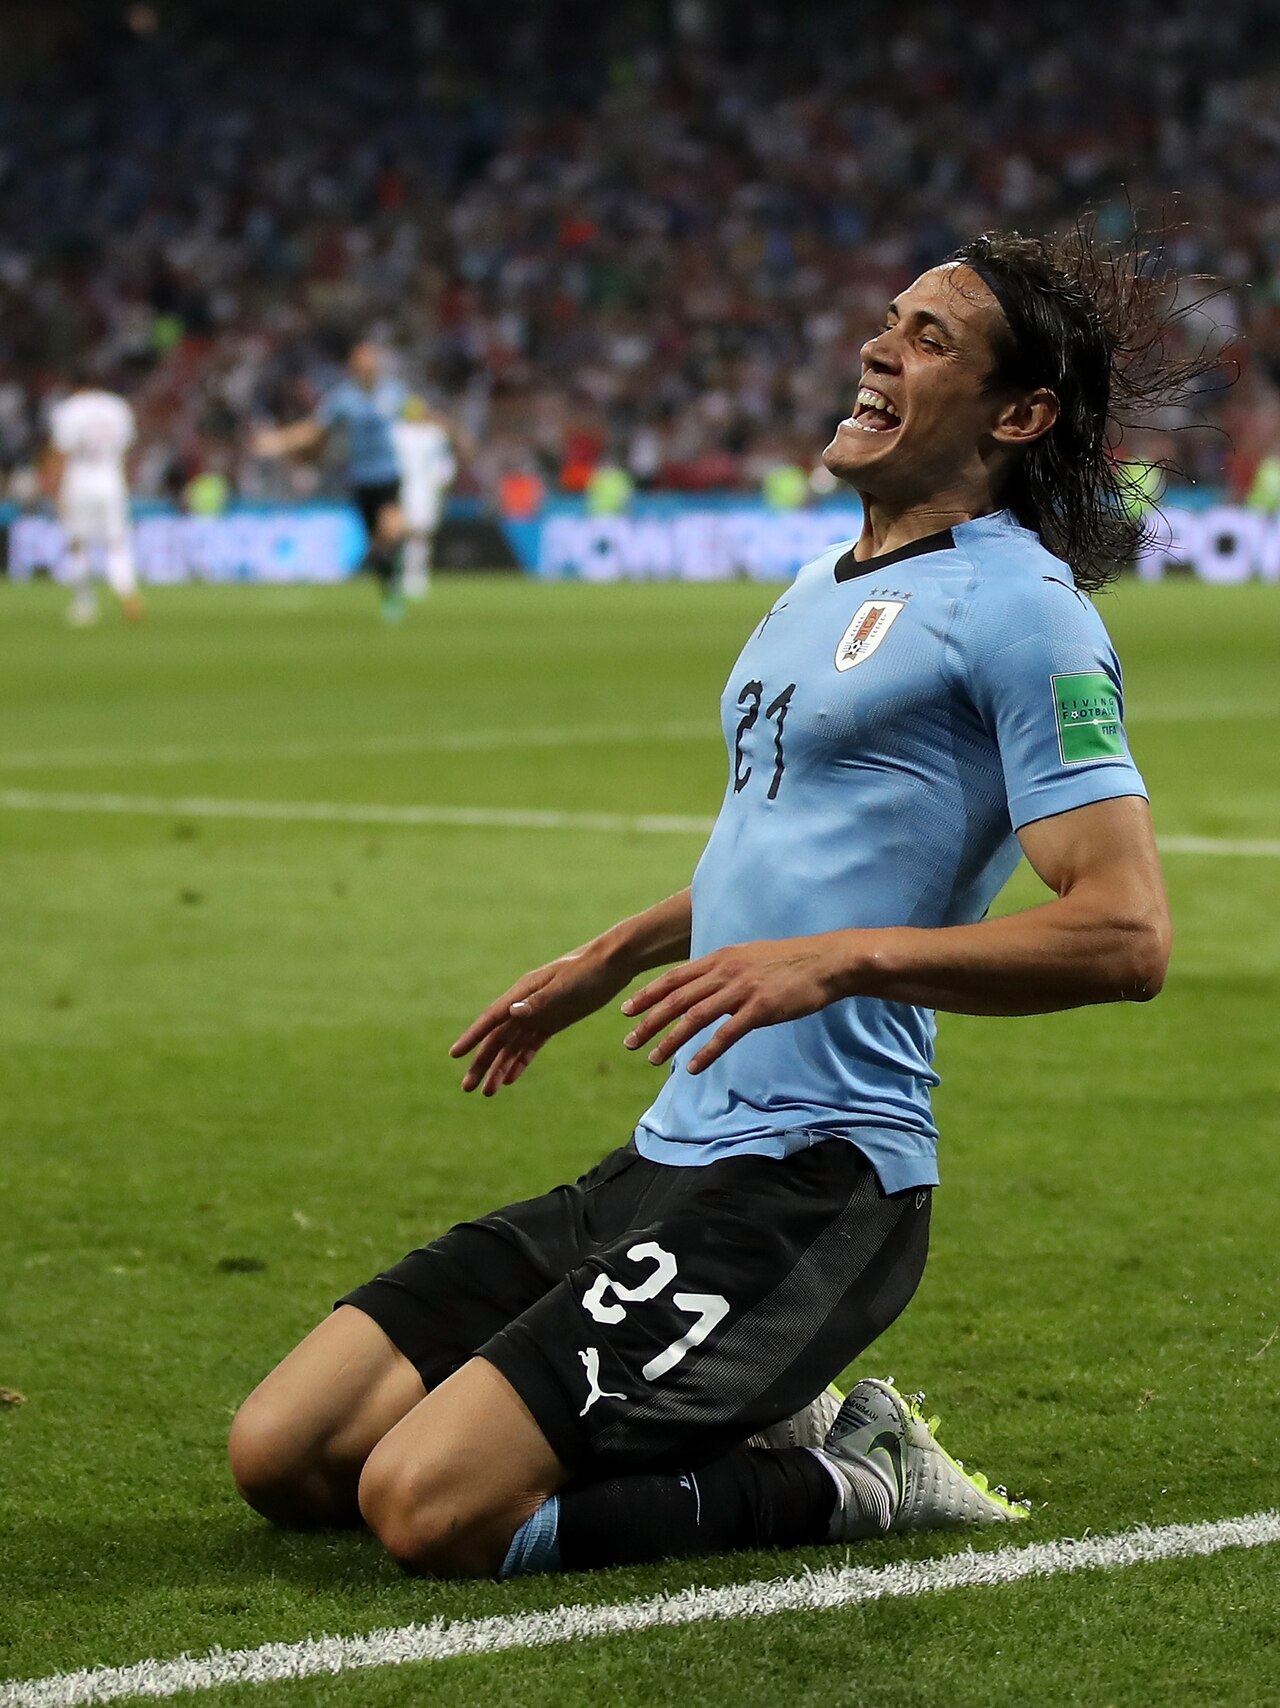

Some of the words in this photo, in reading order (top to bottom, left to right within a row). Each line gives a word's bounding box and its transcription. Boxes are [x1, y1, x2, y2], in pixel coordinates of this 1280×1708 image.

[1061, 698, 1114, 710] LIVING
[1063, 708, 1115, 720] FOOTBALL
[1102, 726, 1118, 735] FIFA
[734, 680, 797, 801] 21
[583, 1241, 730, 1381] 21
